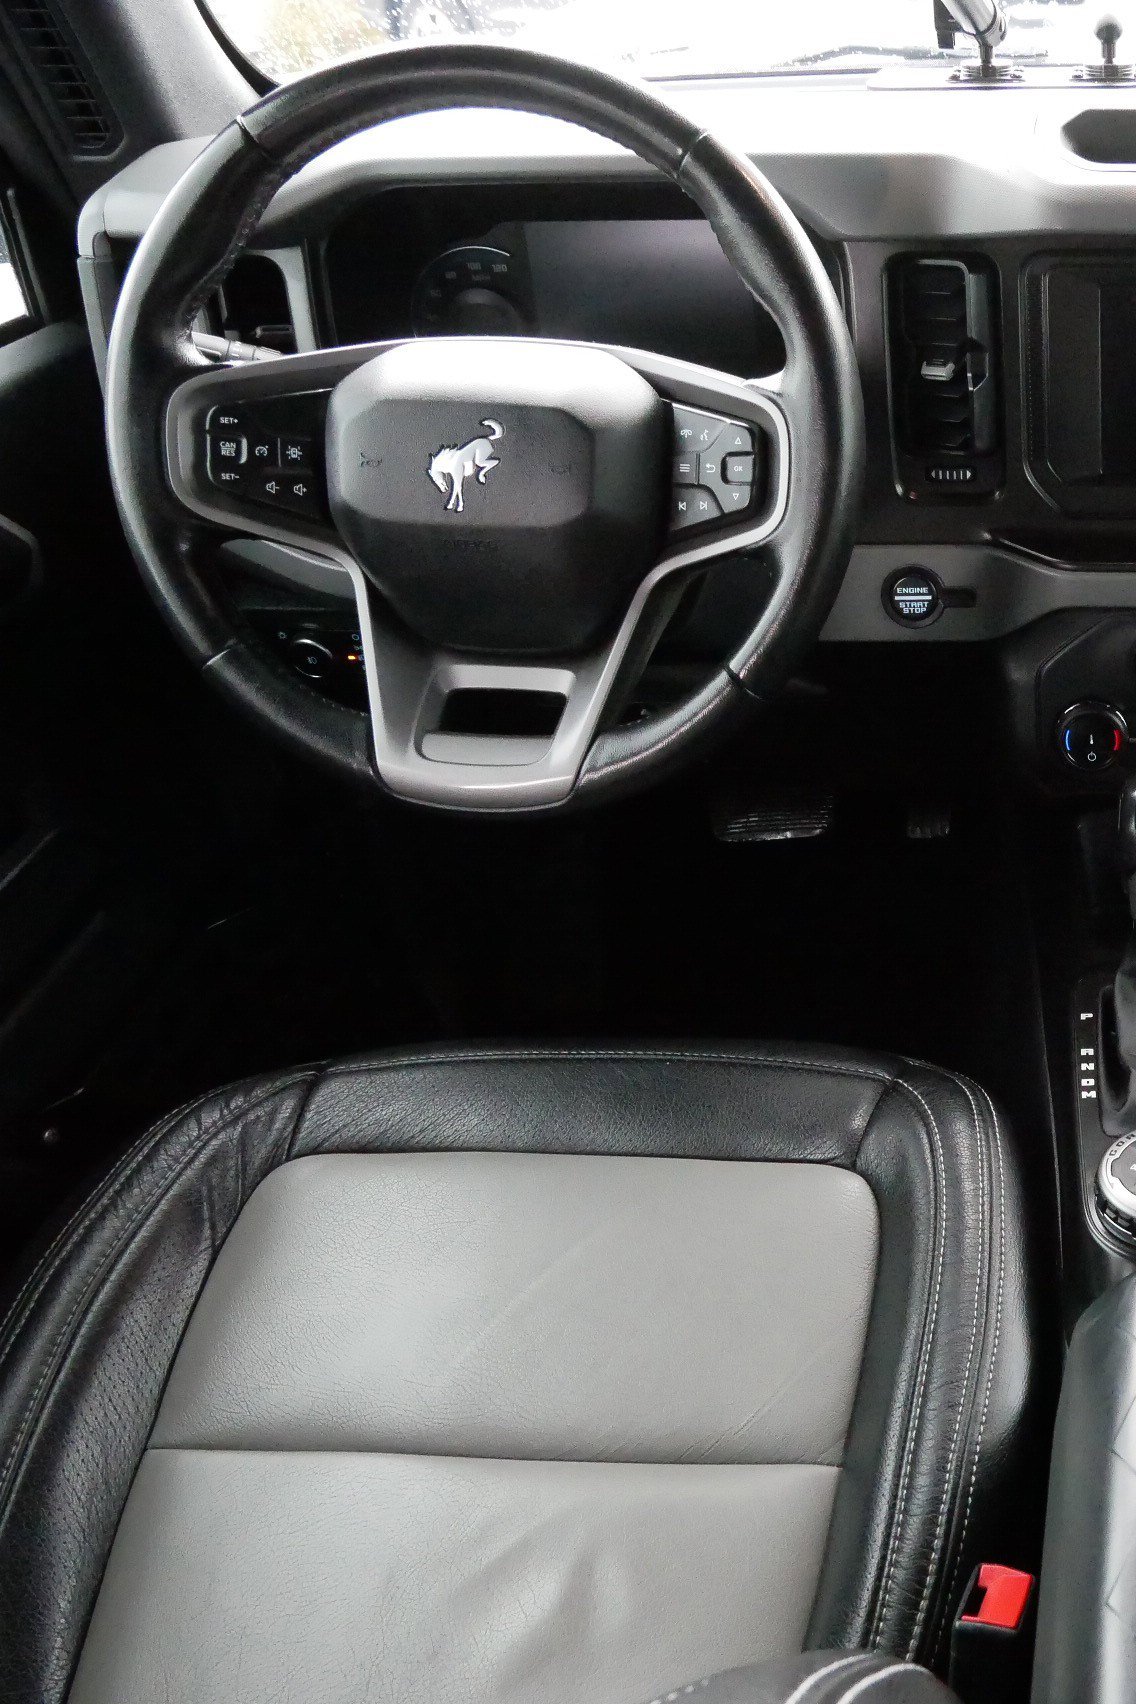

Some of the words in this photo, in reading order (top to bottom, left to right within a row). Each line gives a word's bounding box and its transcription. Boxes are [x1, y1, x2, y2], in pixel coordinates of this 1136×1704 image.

[219, 441, 236, 449] CAN
[221, 449, 236, 457] RES
[733, 465, 744, 473] OK
[1080, 1048, 1095, 1056] R
[1080, 1062, 1095, 1071] N
[1081, 1078, 1096, 1087] D
[1081, 1090, 1097, 1099] M
